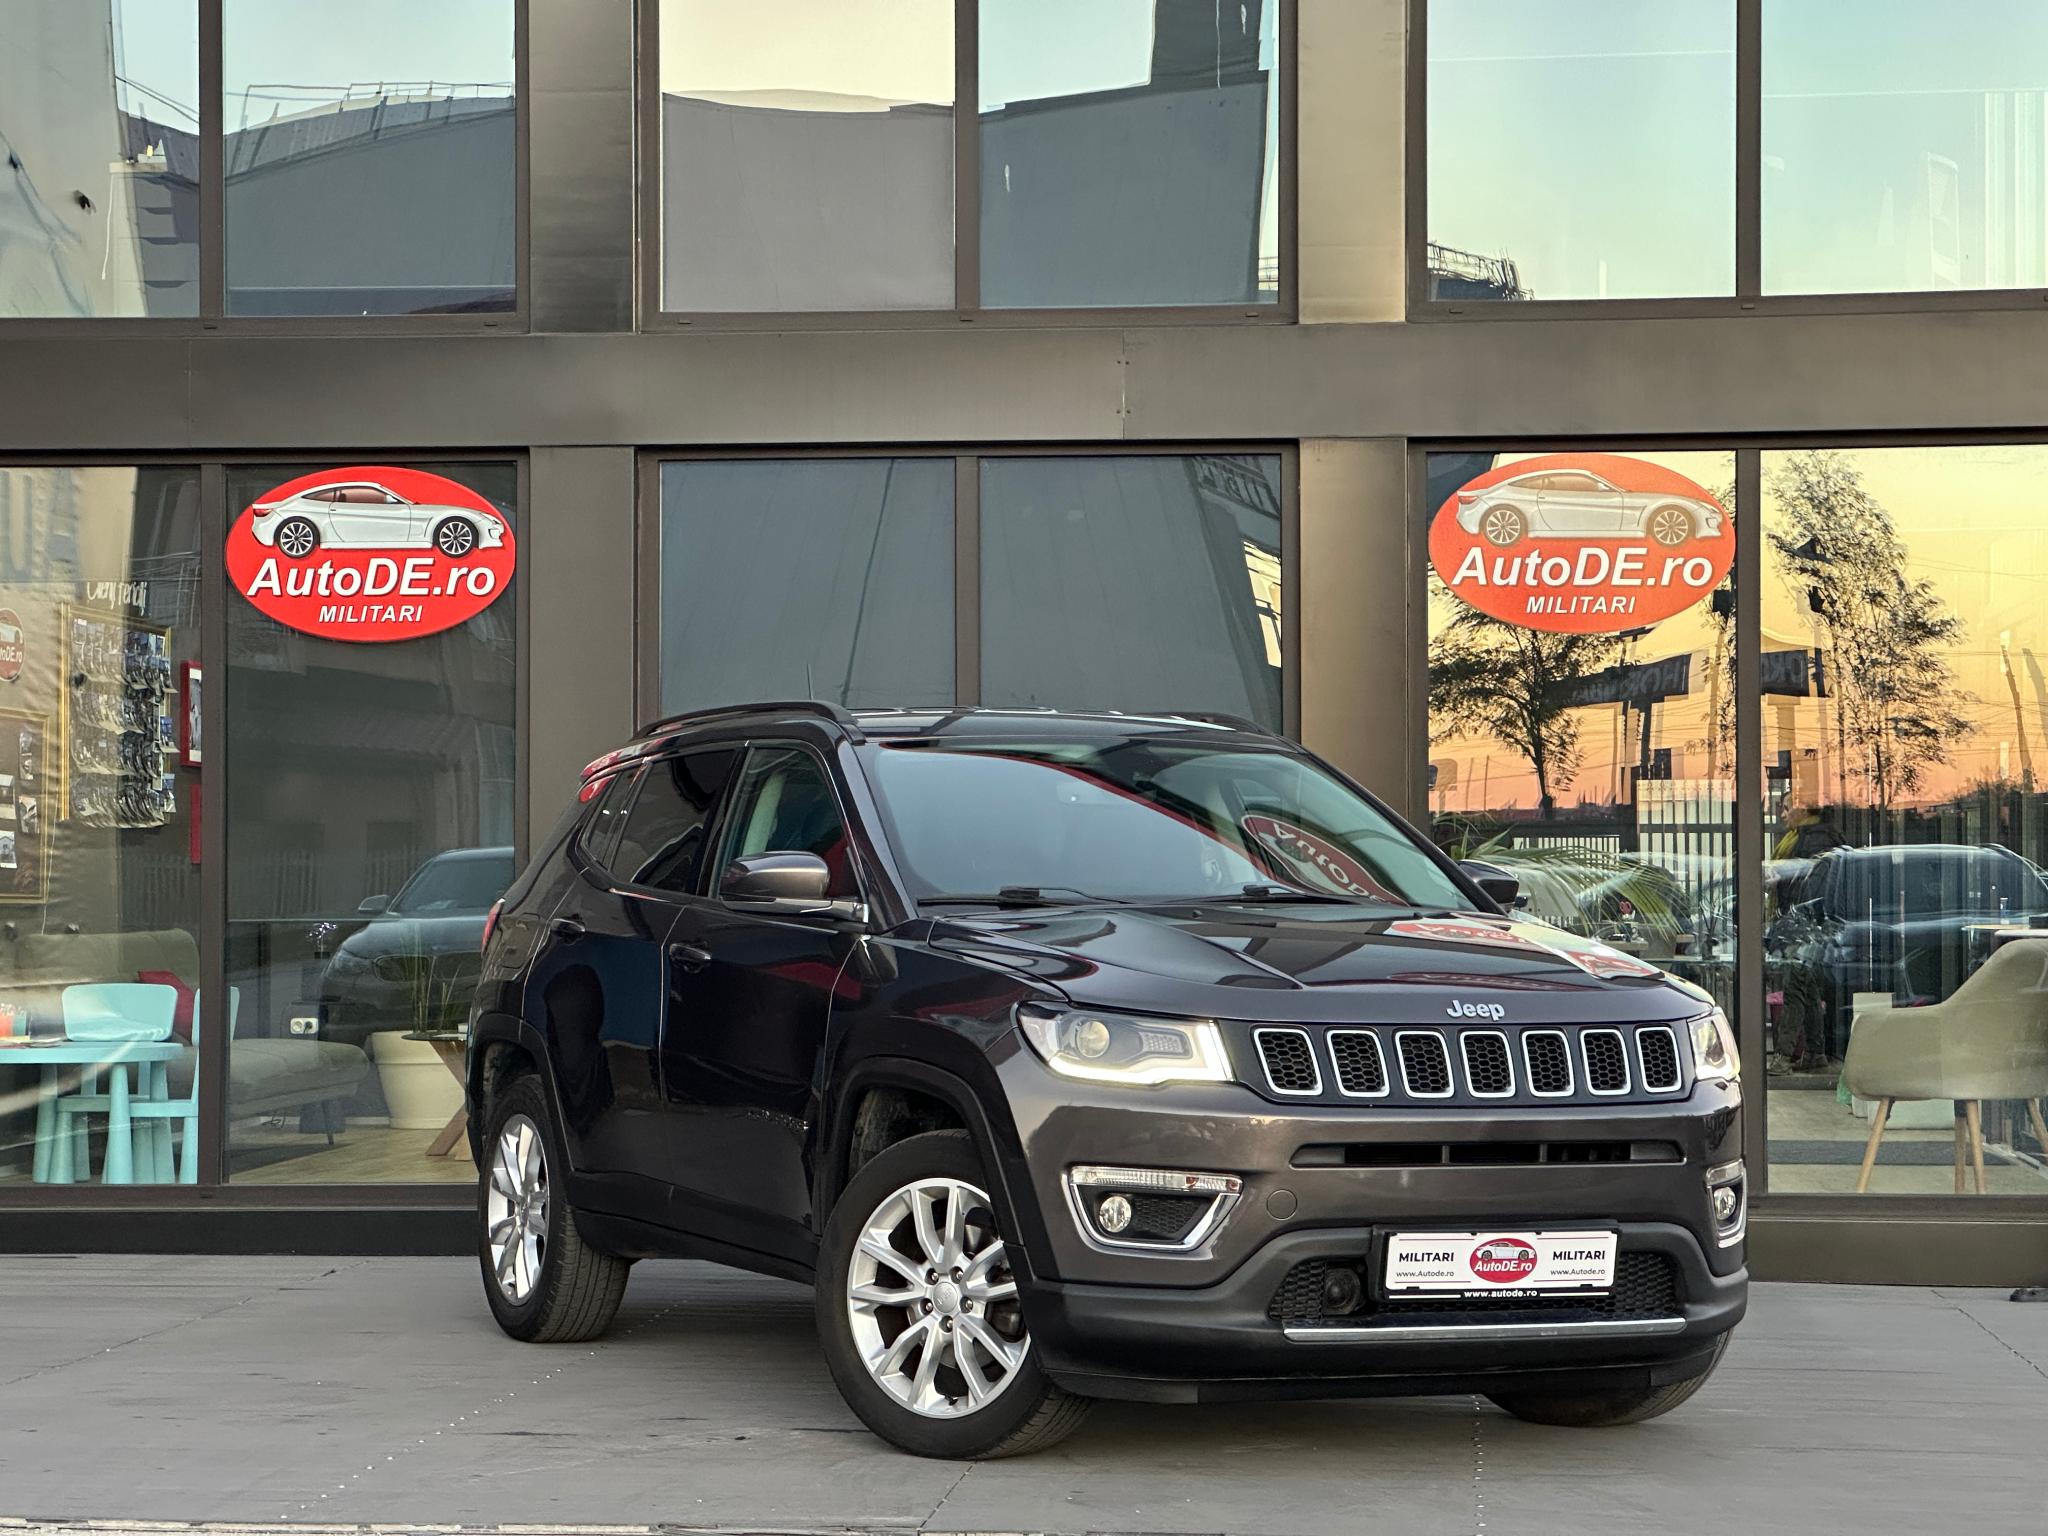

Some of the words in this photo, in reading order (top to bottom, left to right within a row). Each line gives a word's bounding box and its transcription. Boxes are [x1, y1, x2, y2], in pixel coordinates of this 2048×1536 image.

[1452, 547, 1713, 586] AutoDE.ro
[247, 557, 496, 596] AutoDE.ro
[318, 605, 423, 623] MILITARI
[1526, 596, 1636, 614] MILITARI
[1446, 1000, 1505, 1021] Jeep
[1399, 1252, 1455, 1262] MILITARI
[1552, 1250, 1606, 1261] MILITARI
[1474, 1261, 1533, 1272] AutoDE.ro
[1464, 1289, 1538, 1298] www.autode.ro
